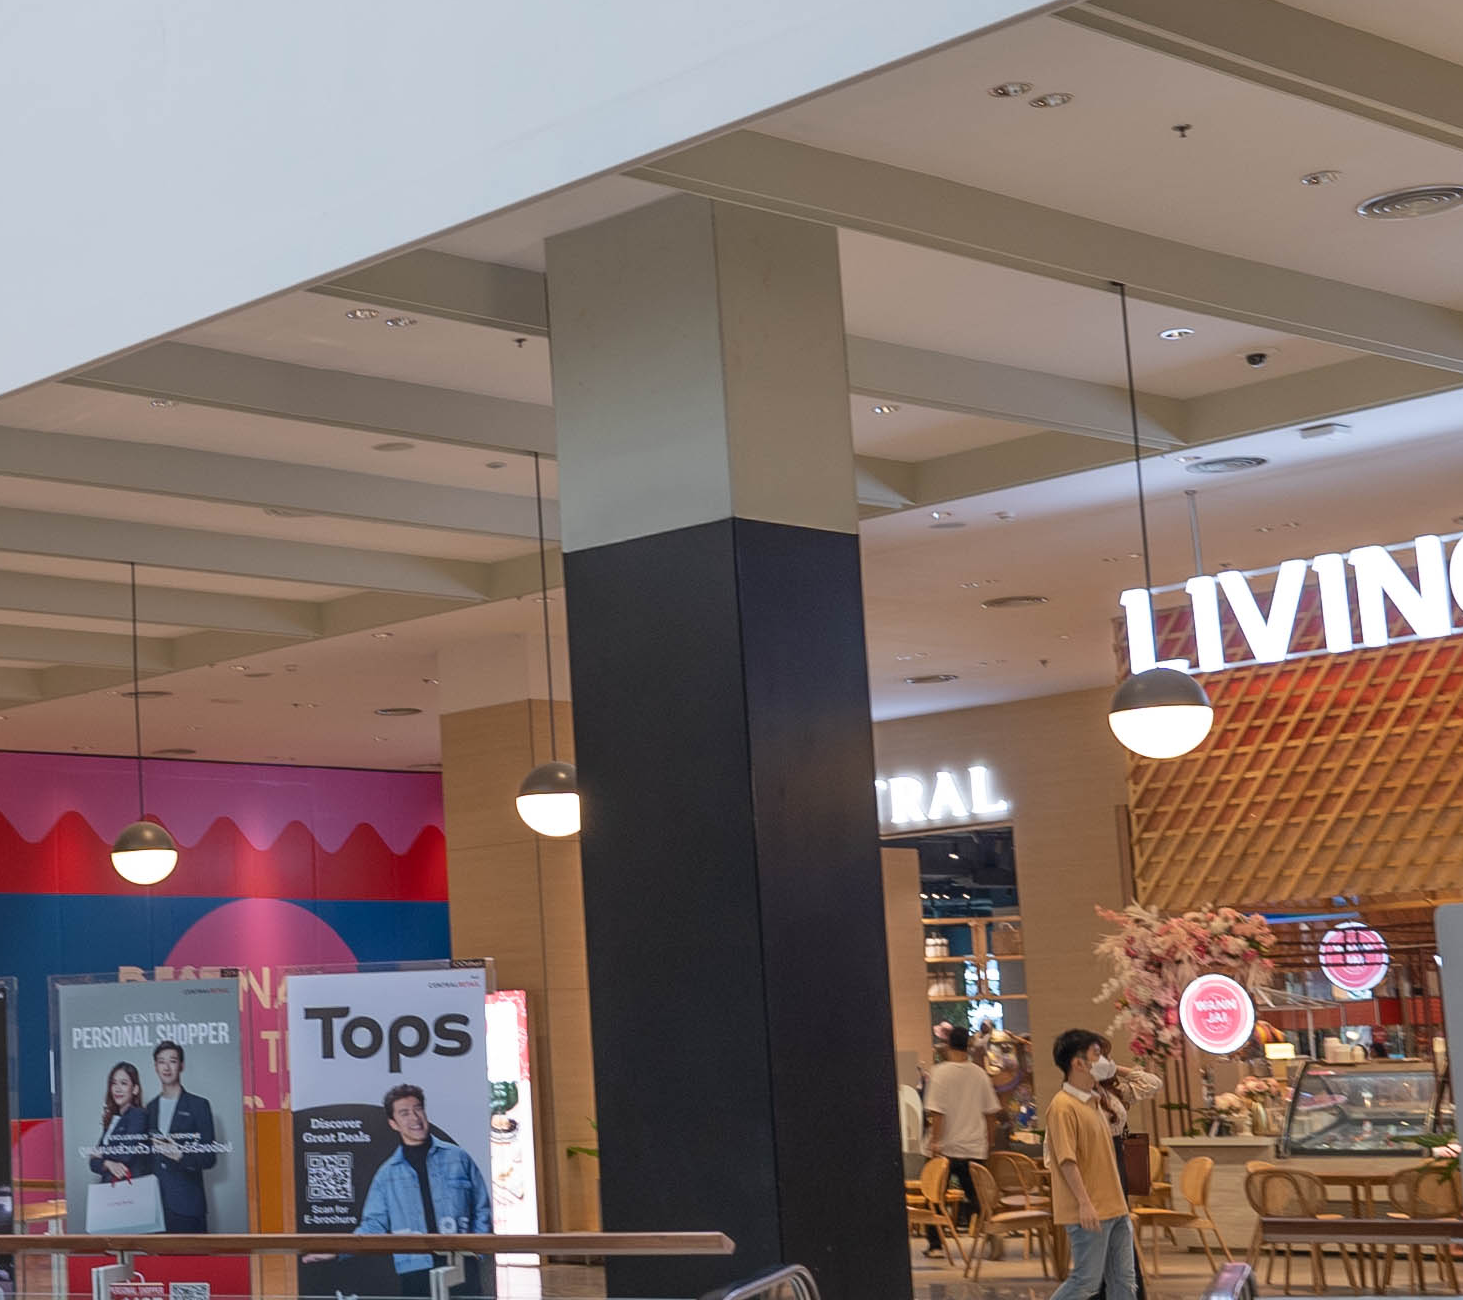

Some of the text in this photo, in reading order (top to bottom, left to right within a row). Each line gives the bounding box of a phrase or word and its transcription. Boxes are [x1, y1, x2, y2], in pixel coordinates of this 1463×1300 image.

[874, 766, 1008, 824] RAL
[1195, 999, 1238, 1011] WANN
[124, 1012, 179, 1024] CENTRAL
[1206, 1012, 1228, 1023] JAI
[72, 1022, 230, 1049] PERSONAL SHOPPER
[303, 1005, 473, 1073] Tops
[311, 1118, 363, 1130] Discover
[303, 1131, 371, 1144] Great Deals
[311, 1204, 348, 1214] Scan for
[304, 1214, 357, 1225] E-brochure
